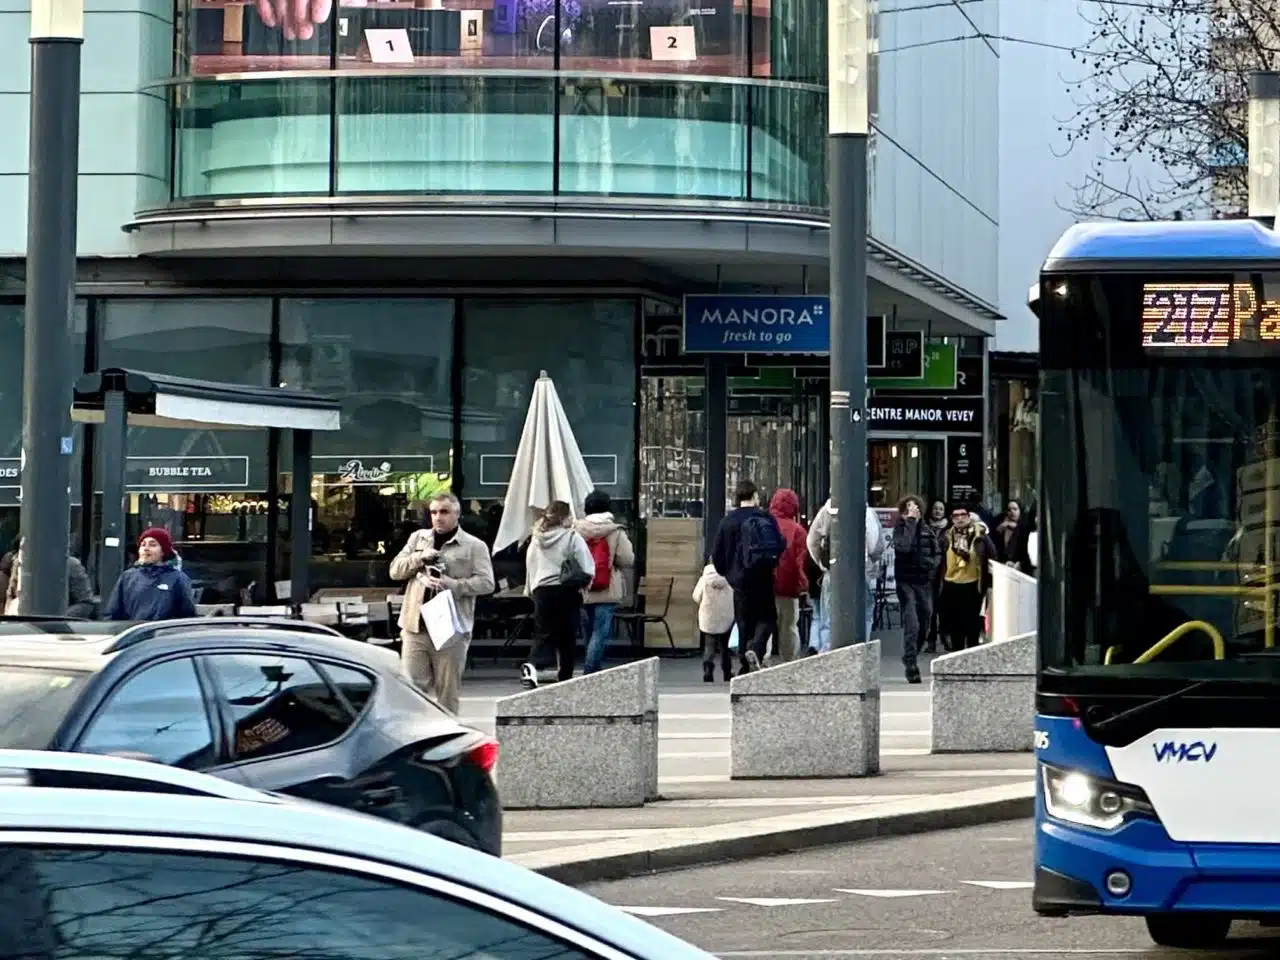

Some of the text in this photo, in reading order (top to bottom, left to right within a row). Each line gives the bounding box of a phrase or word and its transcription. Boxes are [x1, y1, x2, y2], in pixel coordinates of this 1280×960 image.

[385, 40, 395, 52] 1
[666, 36, 678, 49] 2
[700, 308, 814, 325] MANORA
[1150, 287, 1228, 345] 217
[722, 328, 793, 345] fresh to go
[905, 408, 942, 421] MANOR
[945, 410, 975, 422] VEVEY
[149, 467, 212, 477] BUBBLE TEA
[1152, 740, 1217, 763] VMCV
